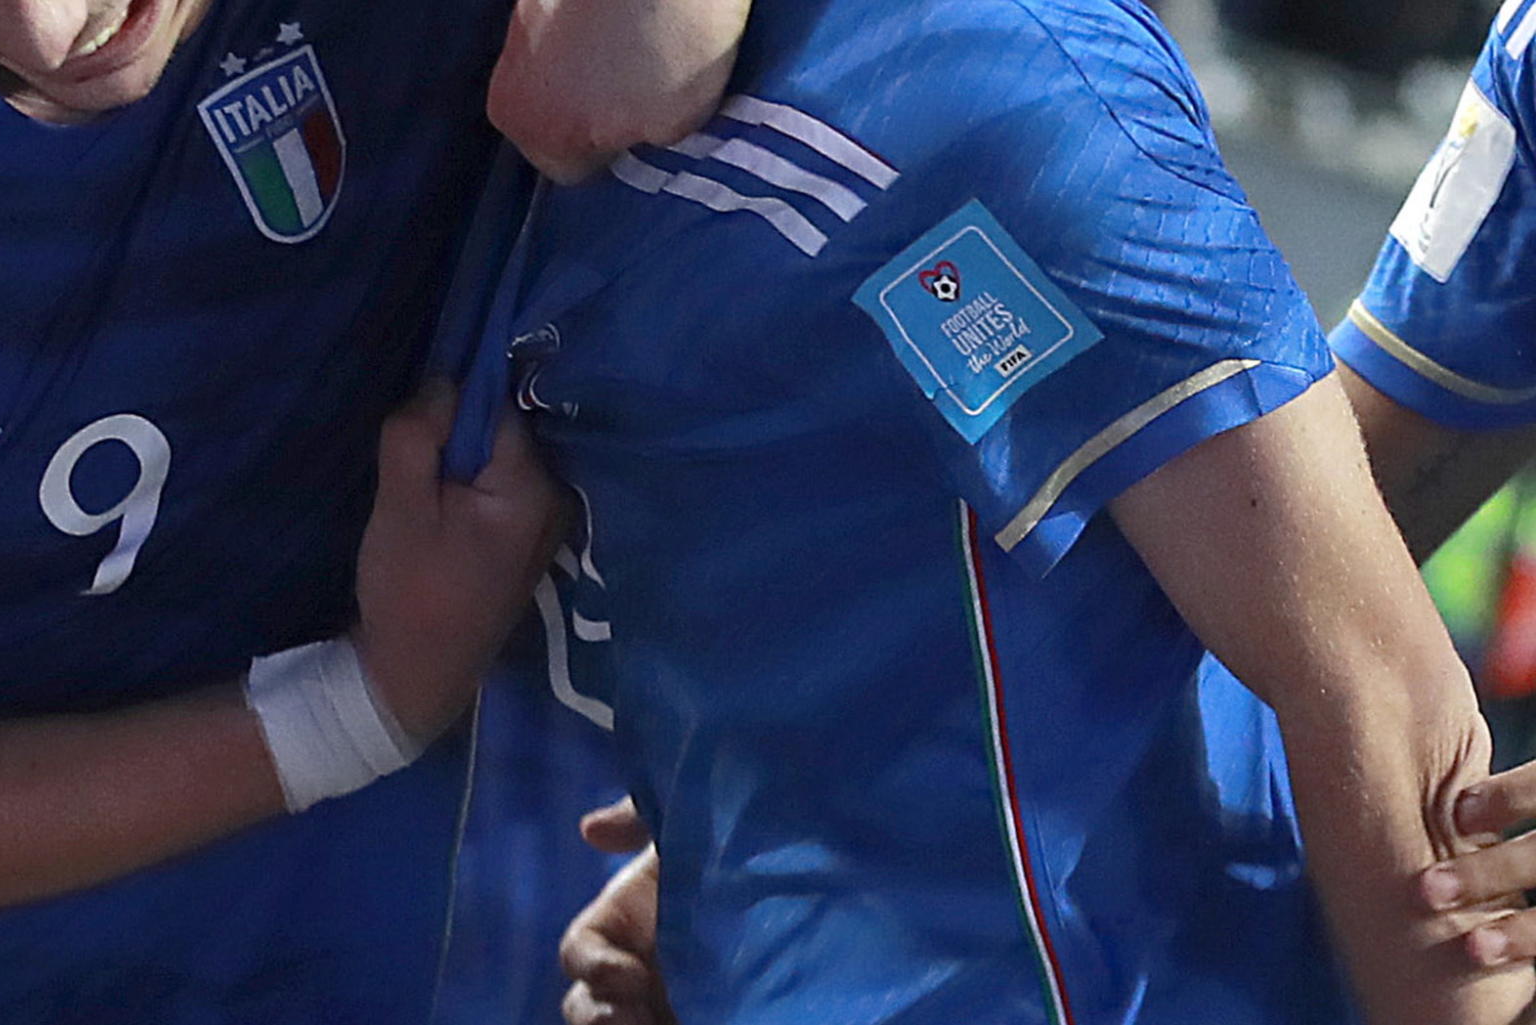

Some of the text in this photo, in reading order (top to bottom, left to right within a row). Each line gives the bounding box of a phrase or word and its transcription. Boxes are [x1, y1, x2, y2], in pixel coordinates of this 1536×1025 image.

[214, 65, 315, 144] ITALIA
[940, 292, 997, 338] FOOTBALL
[952, 303, 1013, 355] UNITES
[967, 317, 1031, 374] the World
[1000, 351, 1026, 371] FIFA
[39, 413, 171, 596] 9
